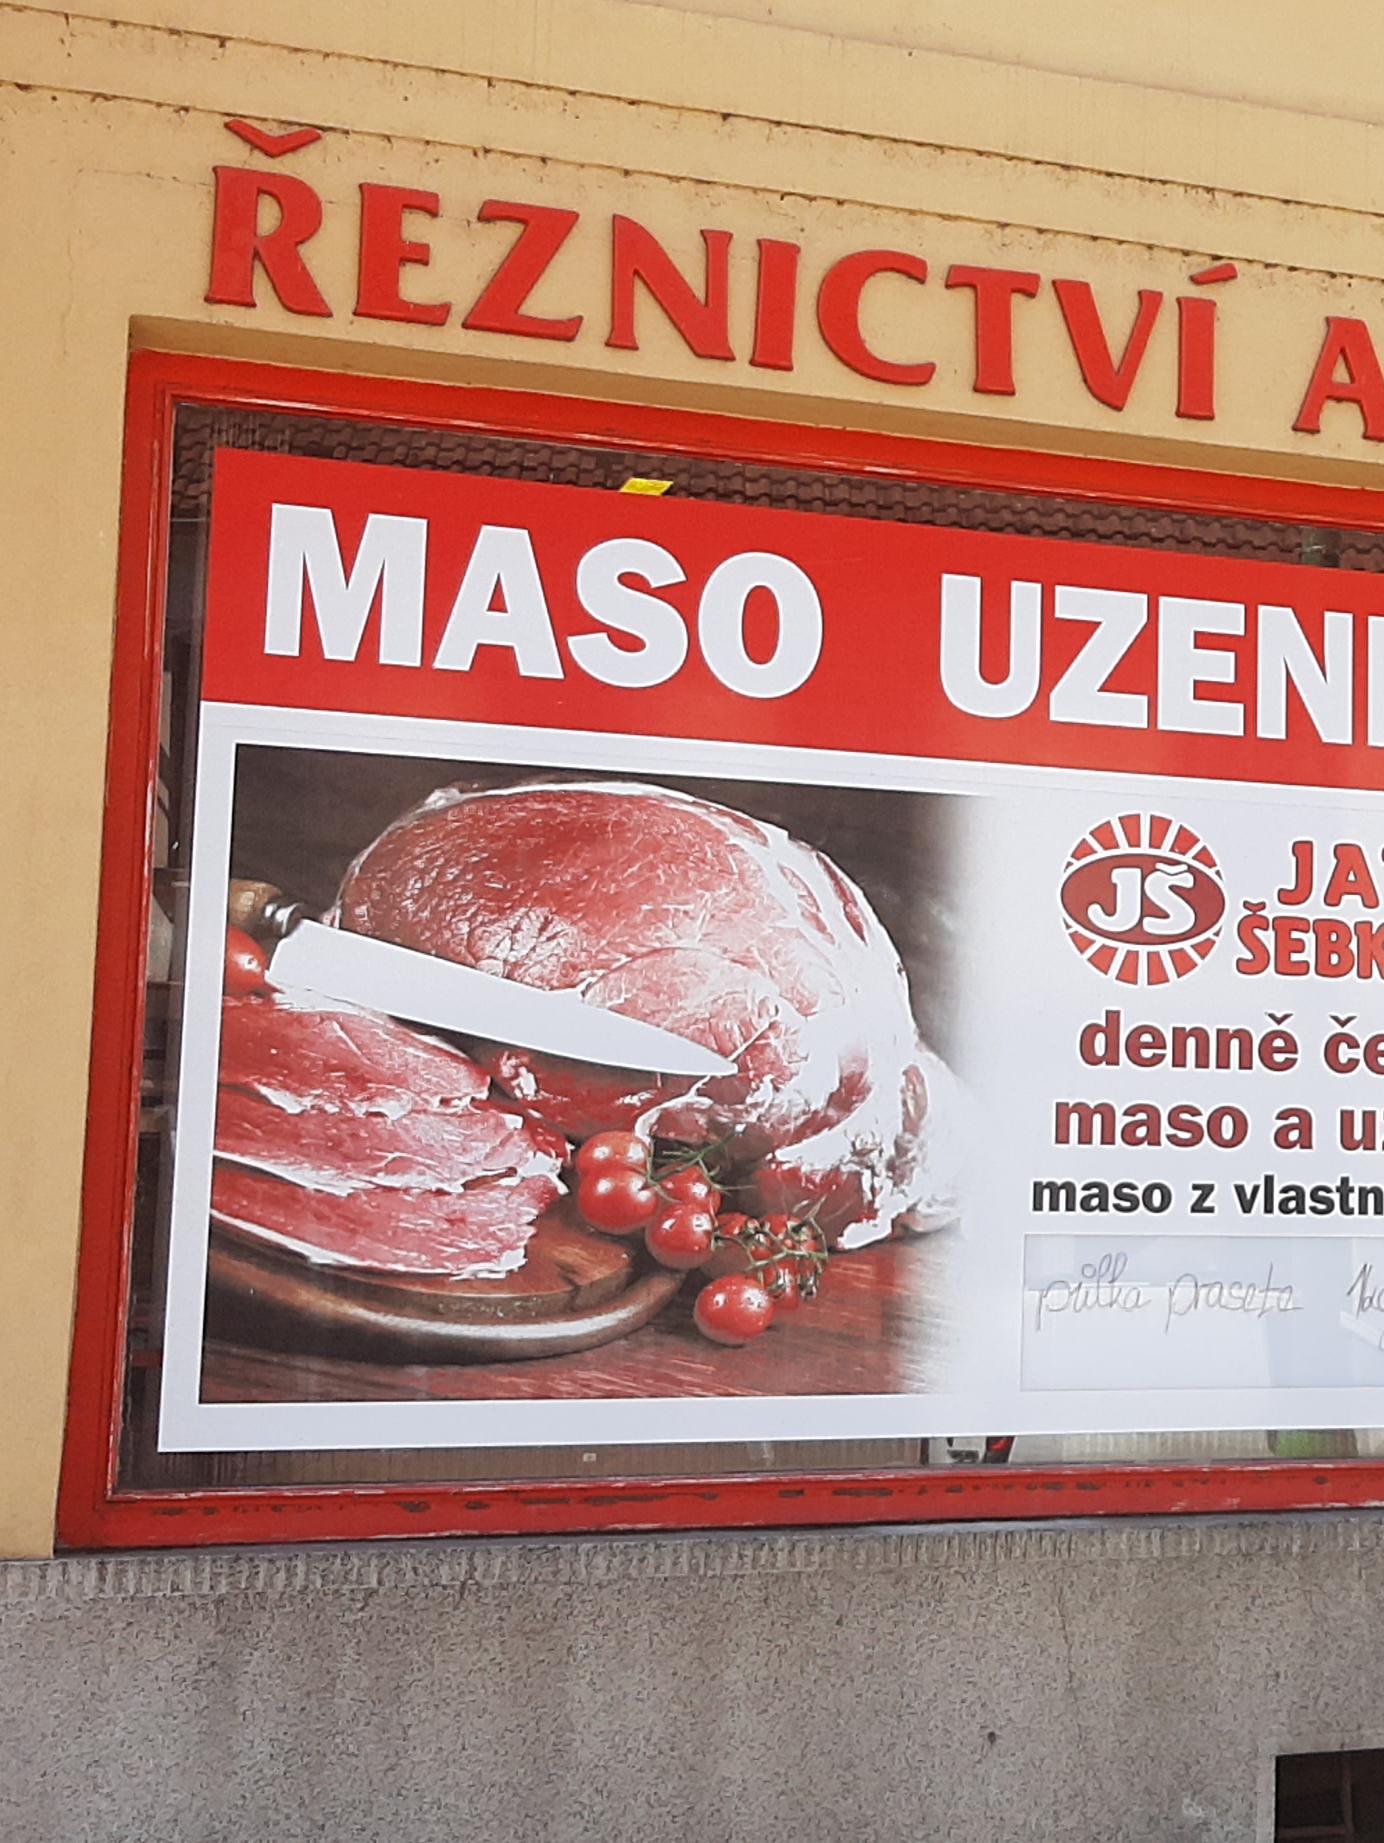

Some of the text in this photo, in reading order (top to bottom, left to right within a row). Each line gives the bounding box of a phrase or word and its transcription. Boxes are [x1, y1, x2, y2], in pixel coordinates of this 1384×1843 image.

[204, 118, 1238, 420] ŘEZNICTVÍ
[264, 503, 823, 699] MASO
[1079, 1009, 1299, 1070] denně
[1054, 1101, 1250, 1149] maso
[1273, 1107, 1314, 1151] a
[1031, 1178, 1173, 1214] maso
[1190, 1183, 1216, 1215] z
